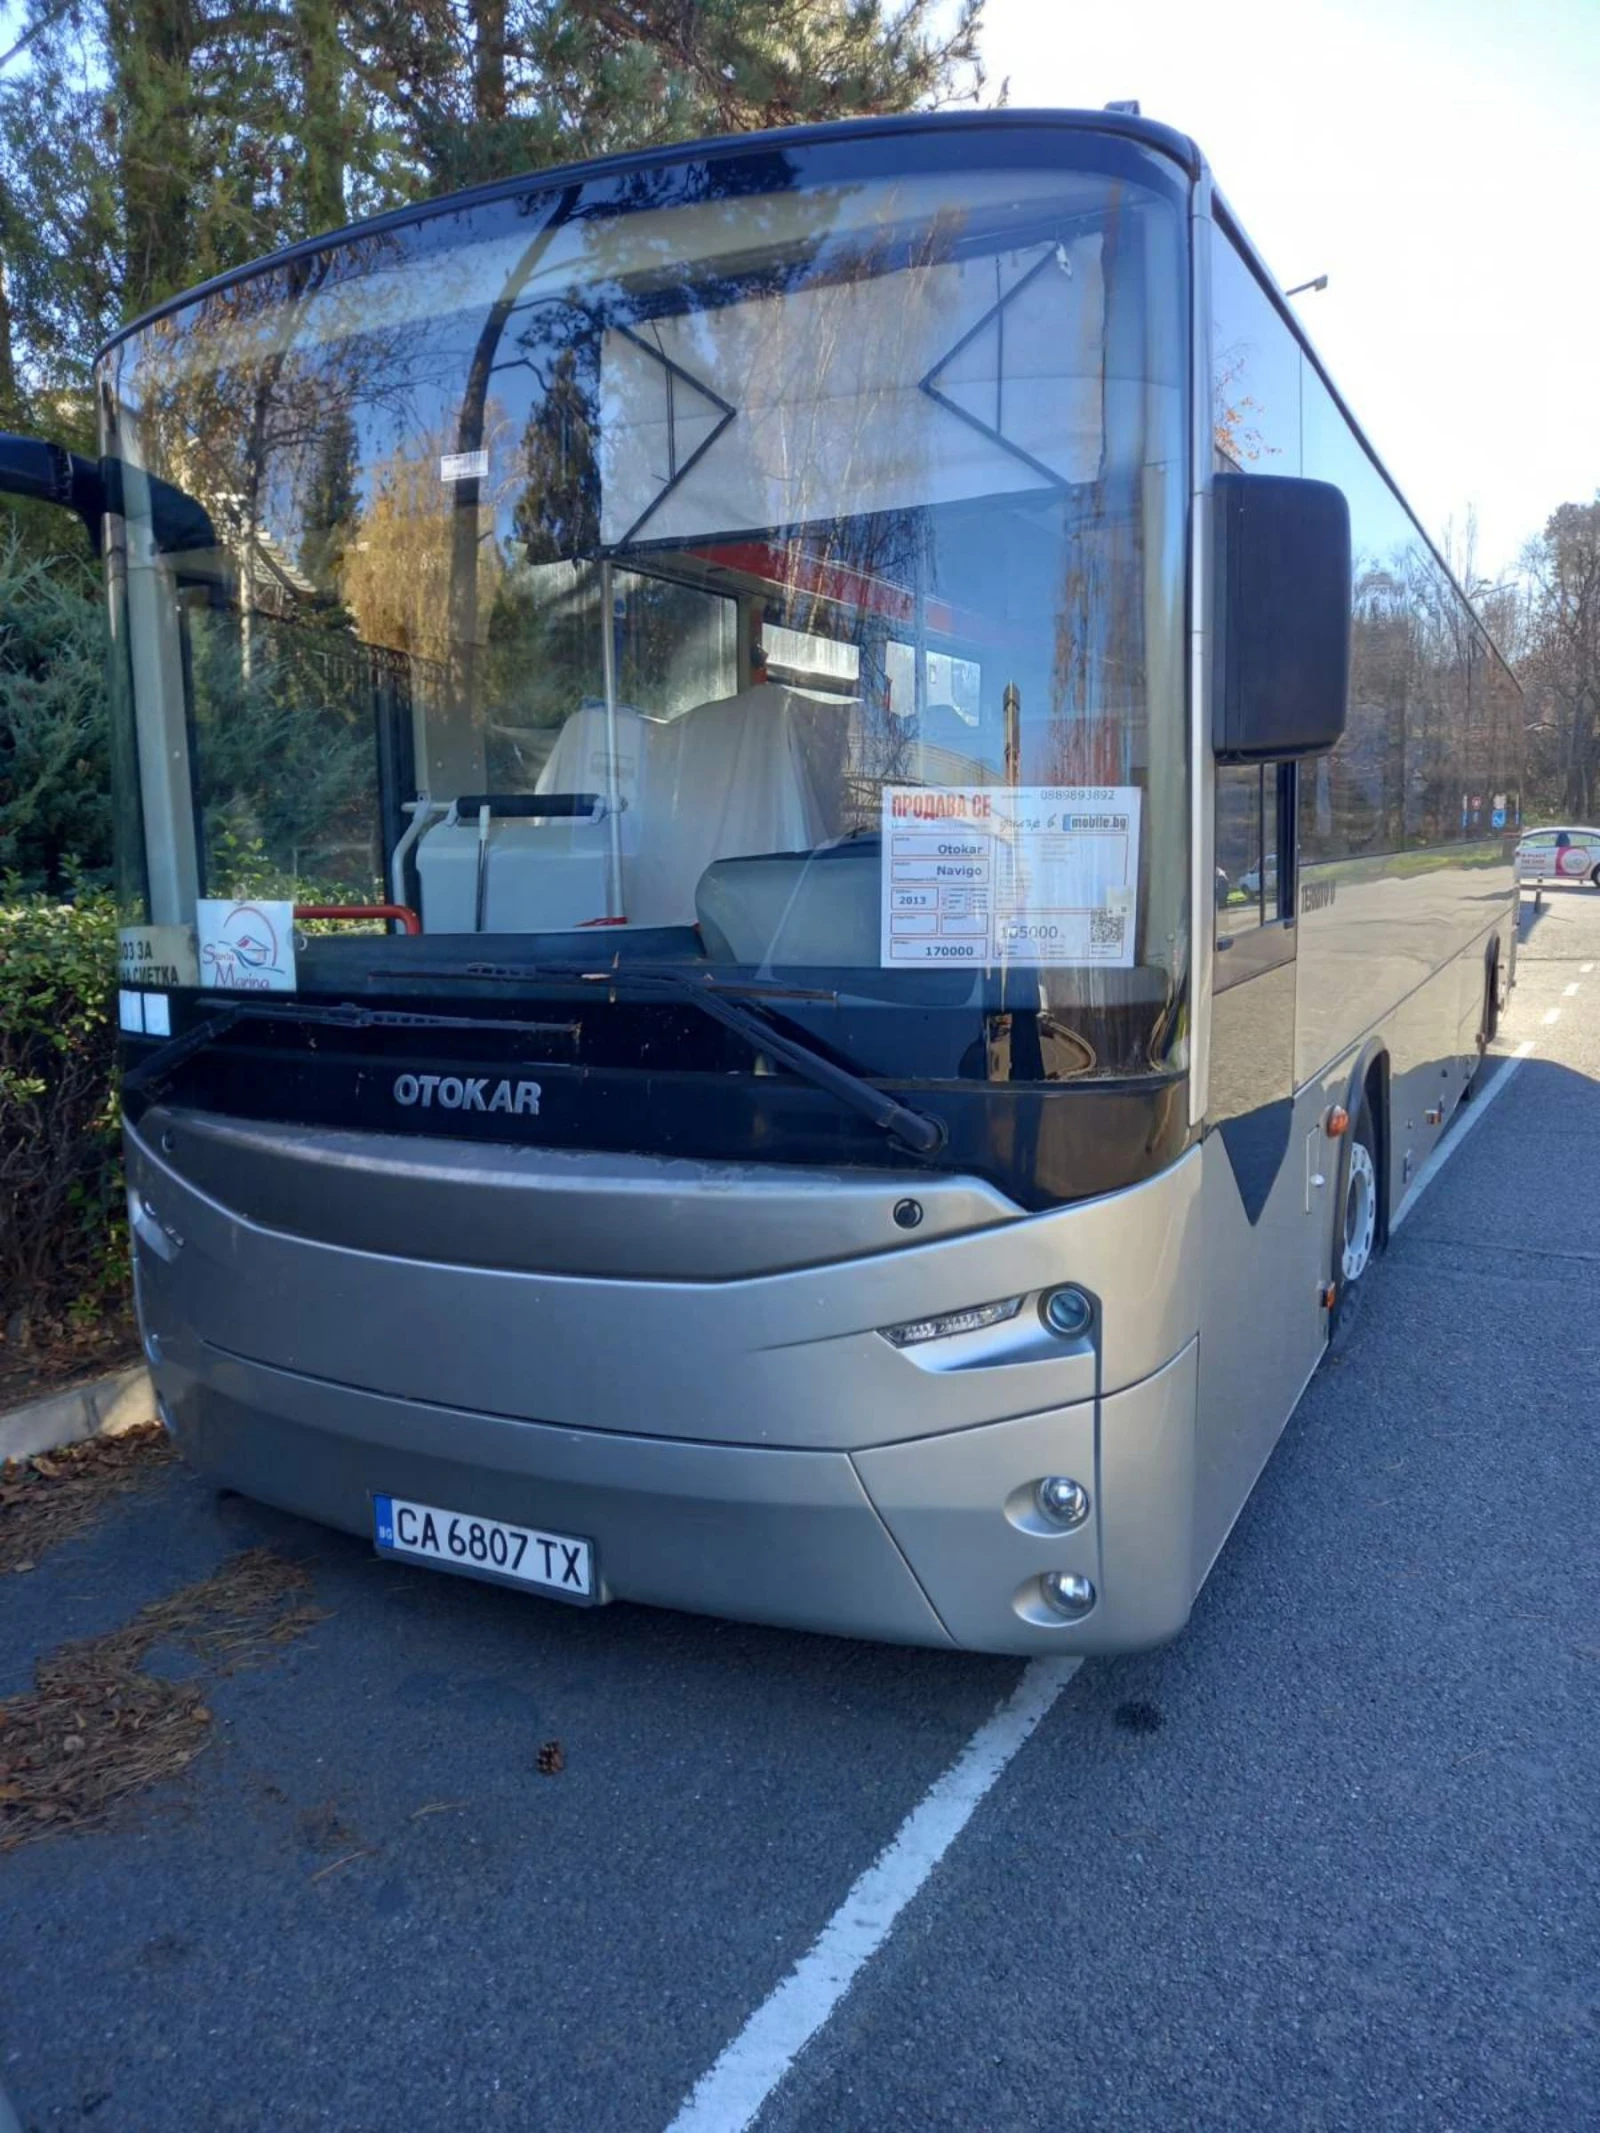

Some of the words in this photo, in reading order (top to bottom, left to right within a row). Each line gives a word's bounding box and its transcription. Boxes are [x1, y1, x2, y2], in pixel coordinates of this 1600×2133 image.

[892, 794, 967, 820] ПРОДАВА
[972, 794, 991, 817] СЕ
[1071, 814, 1127, 830] mobile.bg
[938, 844, 983, 854] Otokar
[936, 865, 982, 878] Navigo
[925, 946, 974, 956] 170000
[213, 961, 271, 990] Marina
[393, 1074, 542, 1115] OTOKAR
[379, 1525, 393, 1540] BG
